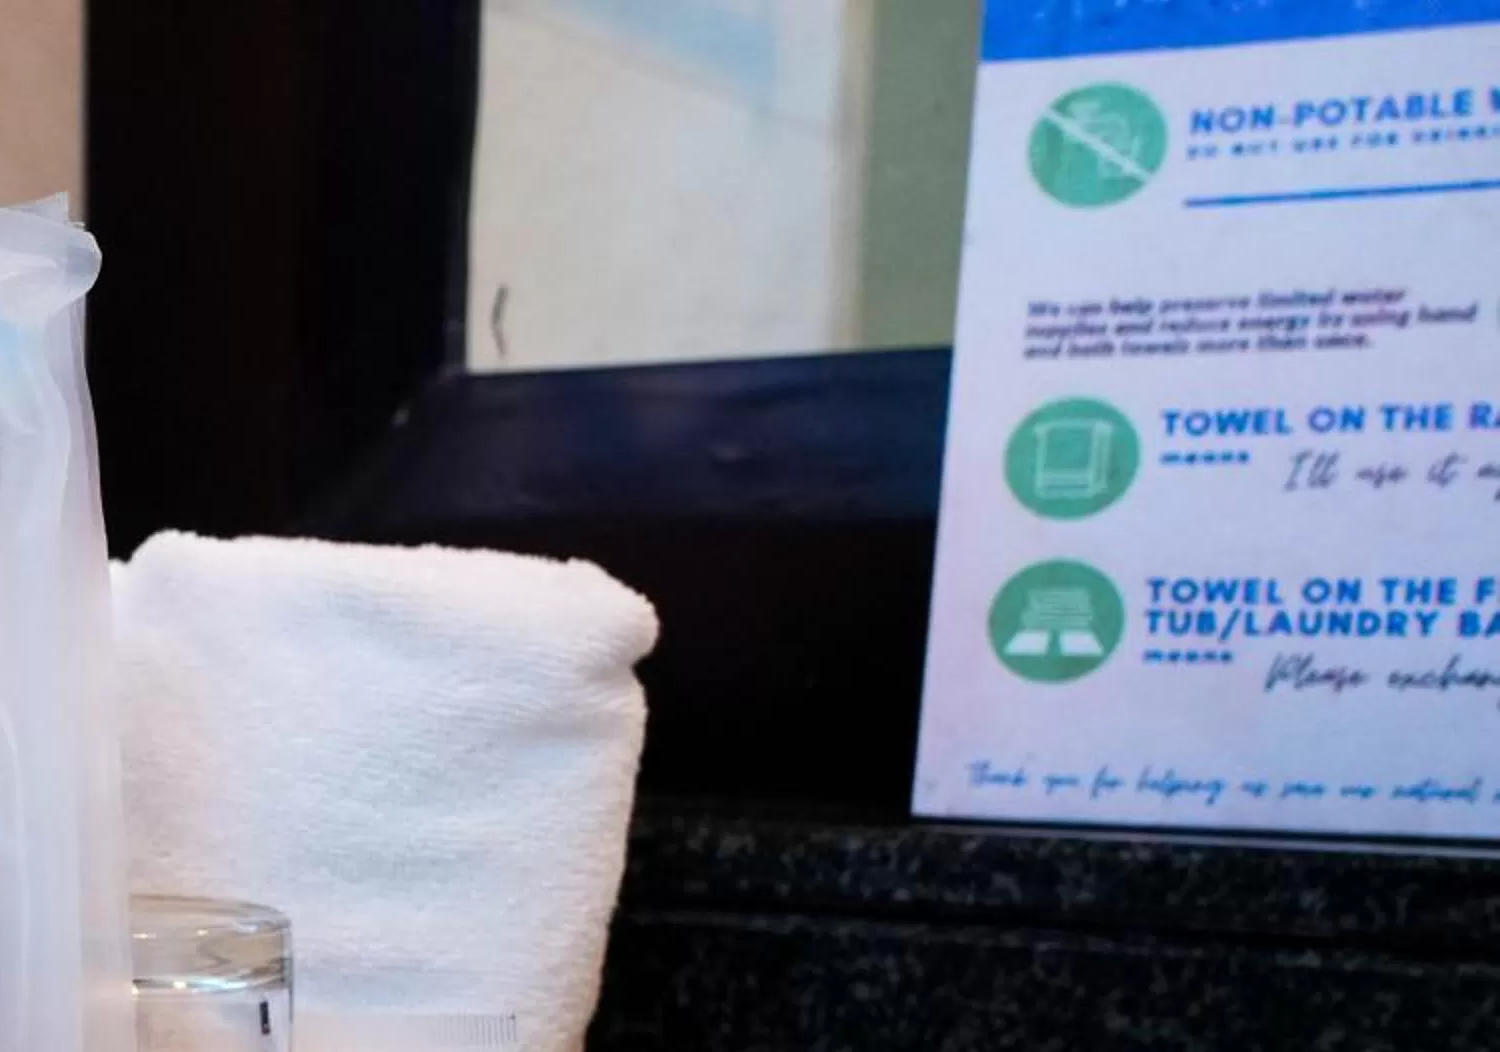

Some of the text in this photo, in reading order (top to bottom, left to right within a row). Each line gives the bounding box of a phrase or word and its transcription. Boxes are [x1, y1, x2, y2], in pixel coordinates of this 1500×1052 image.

[1161, 406, 1293, 436] TOWEL
[1307, 404, 1366, 433] ON
[1379, 402, 1453, 431] THE
[1146, 577, 1284, 605] TOWEL
[1301, 577, 1362, 605] ON
[1378, 577, 1457, 604] THE
[1145, 608, 1439, 642] TUB/LAUNDRY
[1387, 653, 1500, 700] exchan
